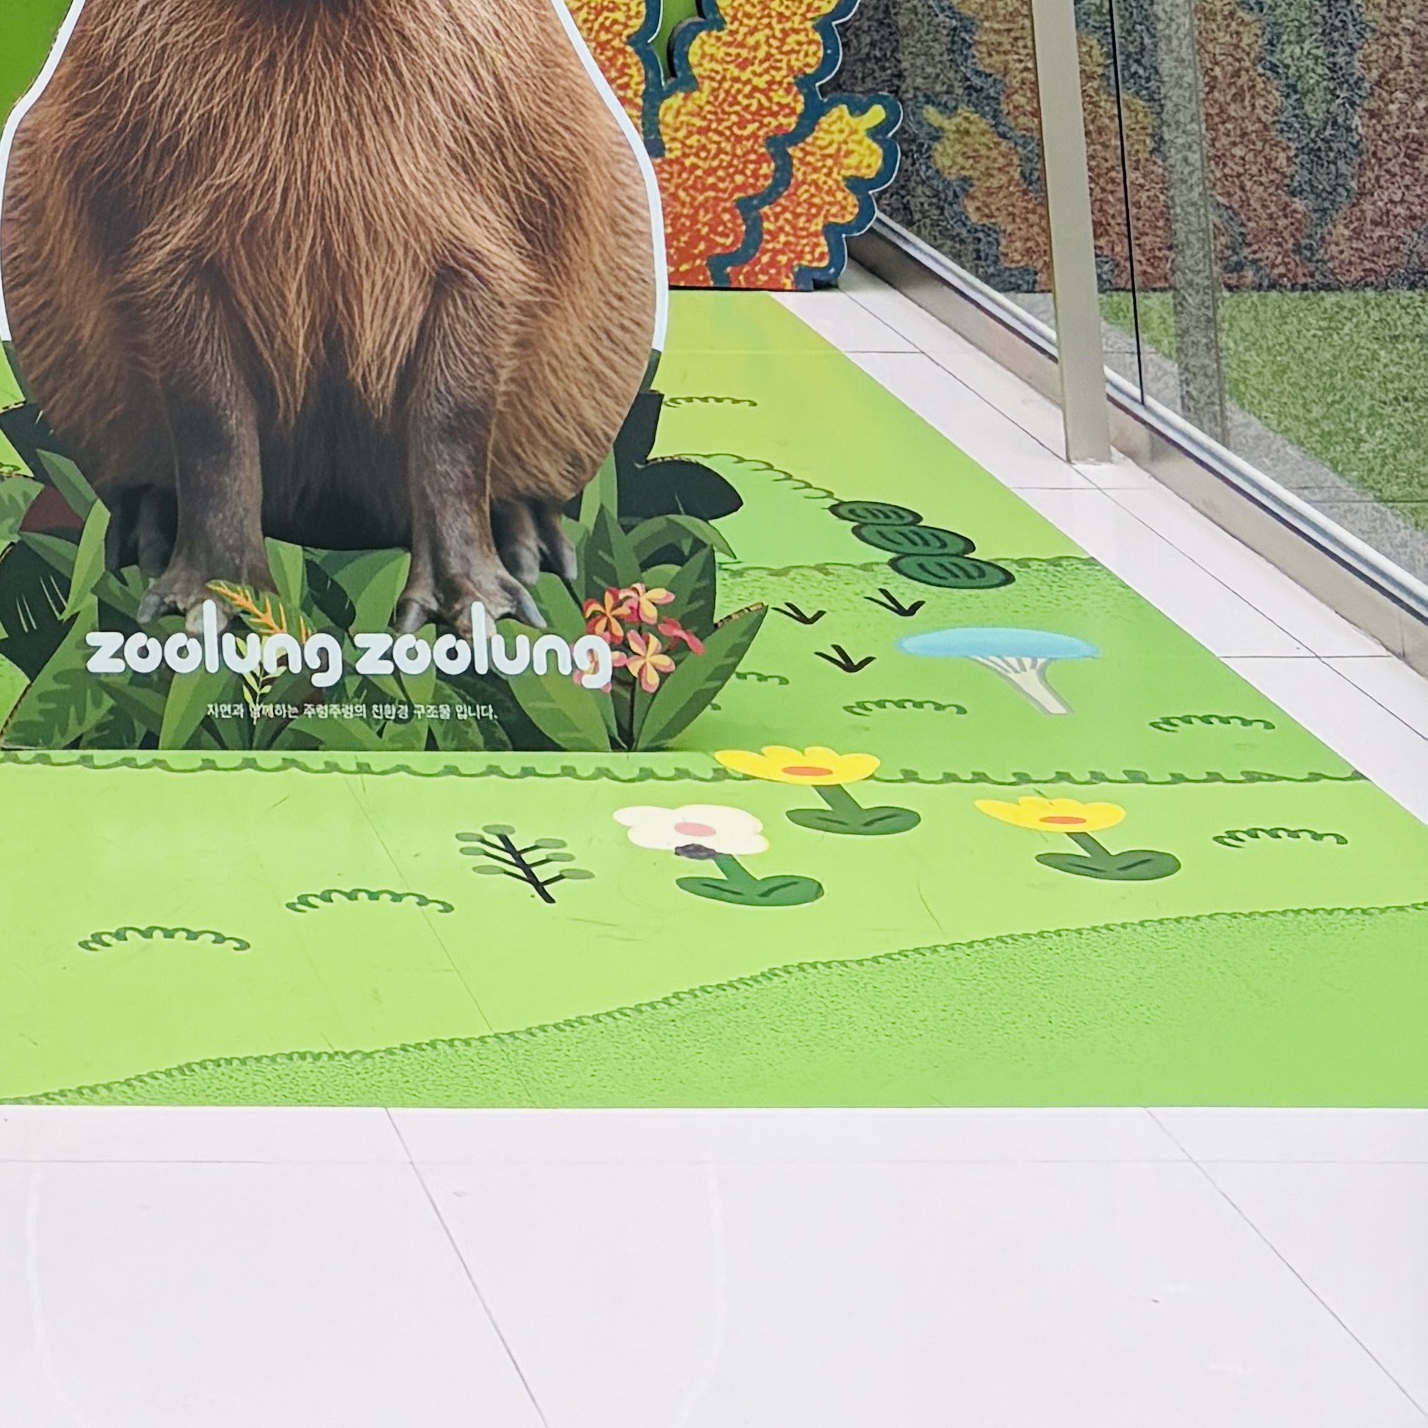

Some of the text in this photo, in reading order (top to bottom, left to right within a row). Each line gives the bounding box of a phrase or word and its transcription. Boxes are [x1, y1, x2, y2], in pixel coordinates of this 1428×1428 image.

[84, 599, 613, 689] zoolung zoolung
[206, 704, 245, 720] 자연과
[303, 703, 367, 720] 주렁주렁의
[371, 703, 409, 720] 친환경
[456, 703, 499, 721] 입니다.
